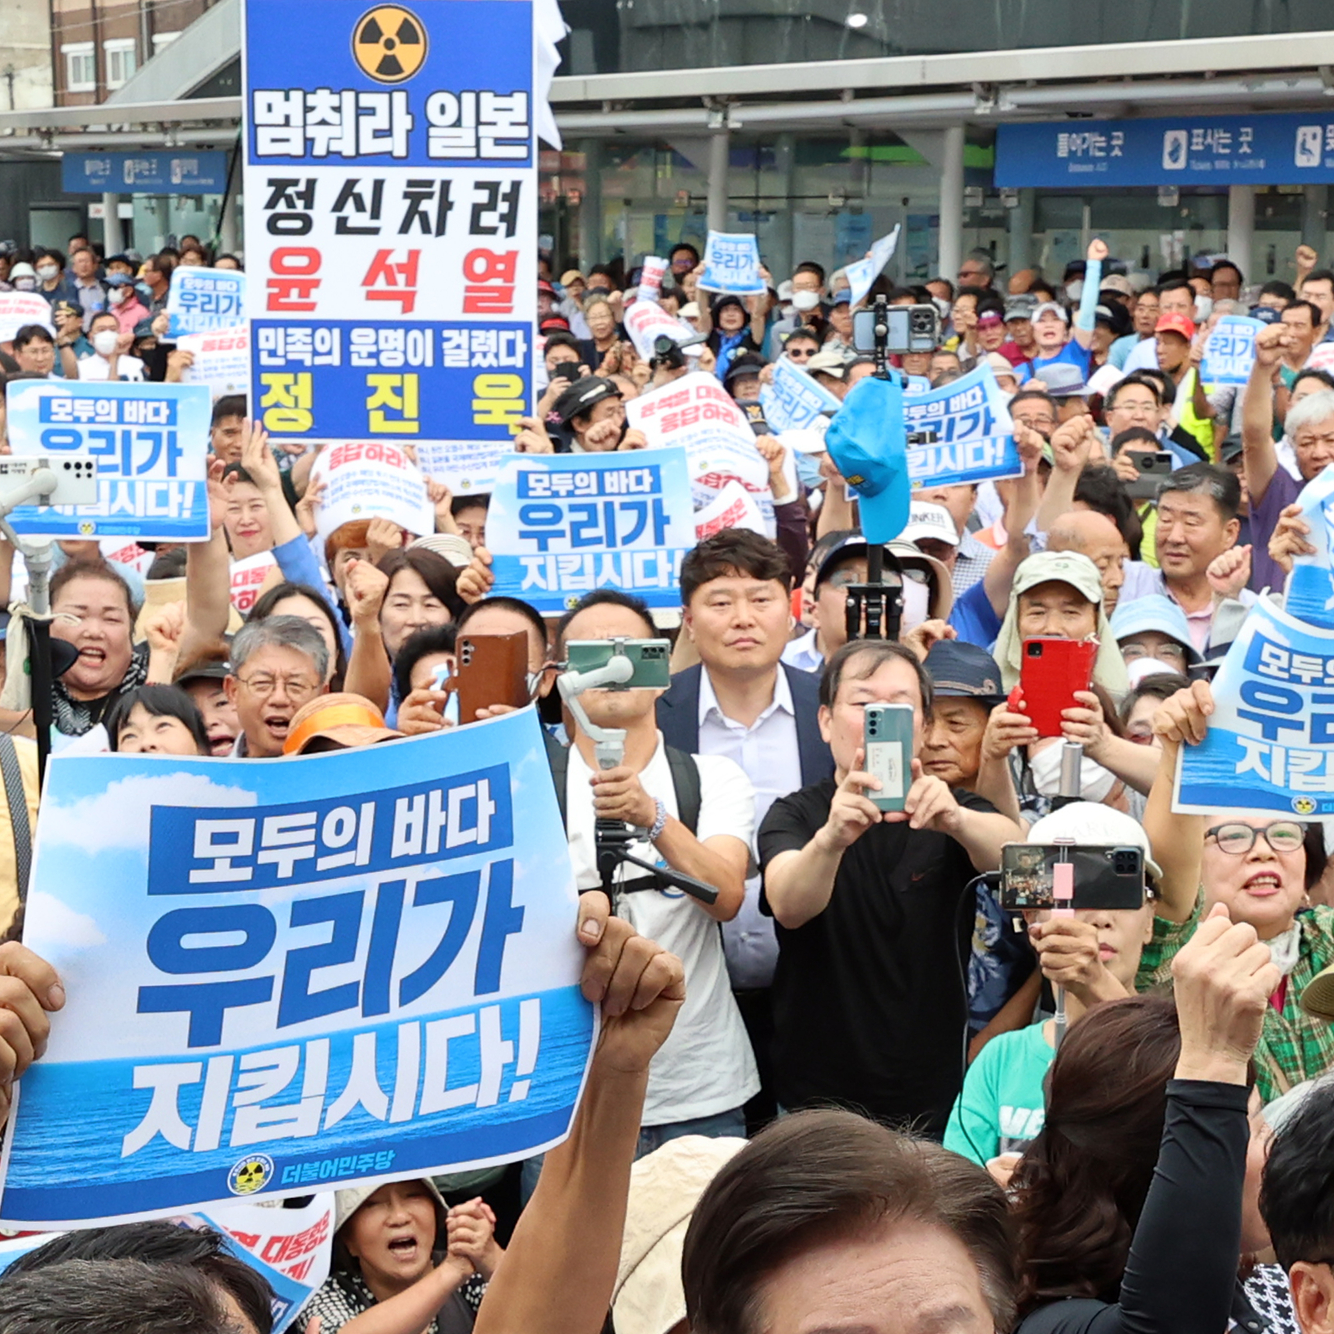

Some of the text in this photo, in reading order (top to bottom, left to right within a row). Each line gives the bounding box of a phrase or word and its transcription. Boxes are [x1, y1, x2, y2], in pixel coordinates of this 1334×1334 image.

[253, 89, 530, 160] 멈춰라 일본
[1238, 126, 1253, 153] 곳
[1110, 131, 1124, 157] 곳
[711, 251, 754, 270] 우리가
[178, 292, 243, 316] 우리가
[257, 328, 527, 368] 민족의 운명이 걸렸다
[50, 398, 170, 424] 모두의 바다
[949, 386, 983, 408] 바다
[527, 465, 654, 497] 모두의 바다
[518, 500, 671, 552] 우리가
[188, 778, 496, 884] 모두의 바다
[136, 858, 526, 1048] 우리가
[121, 998, 541, 1159] 지킵시다!
[281, 1149, 396, 1184] 더불어민주당
